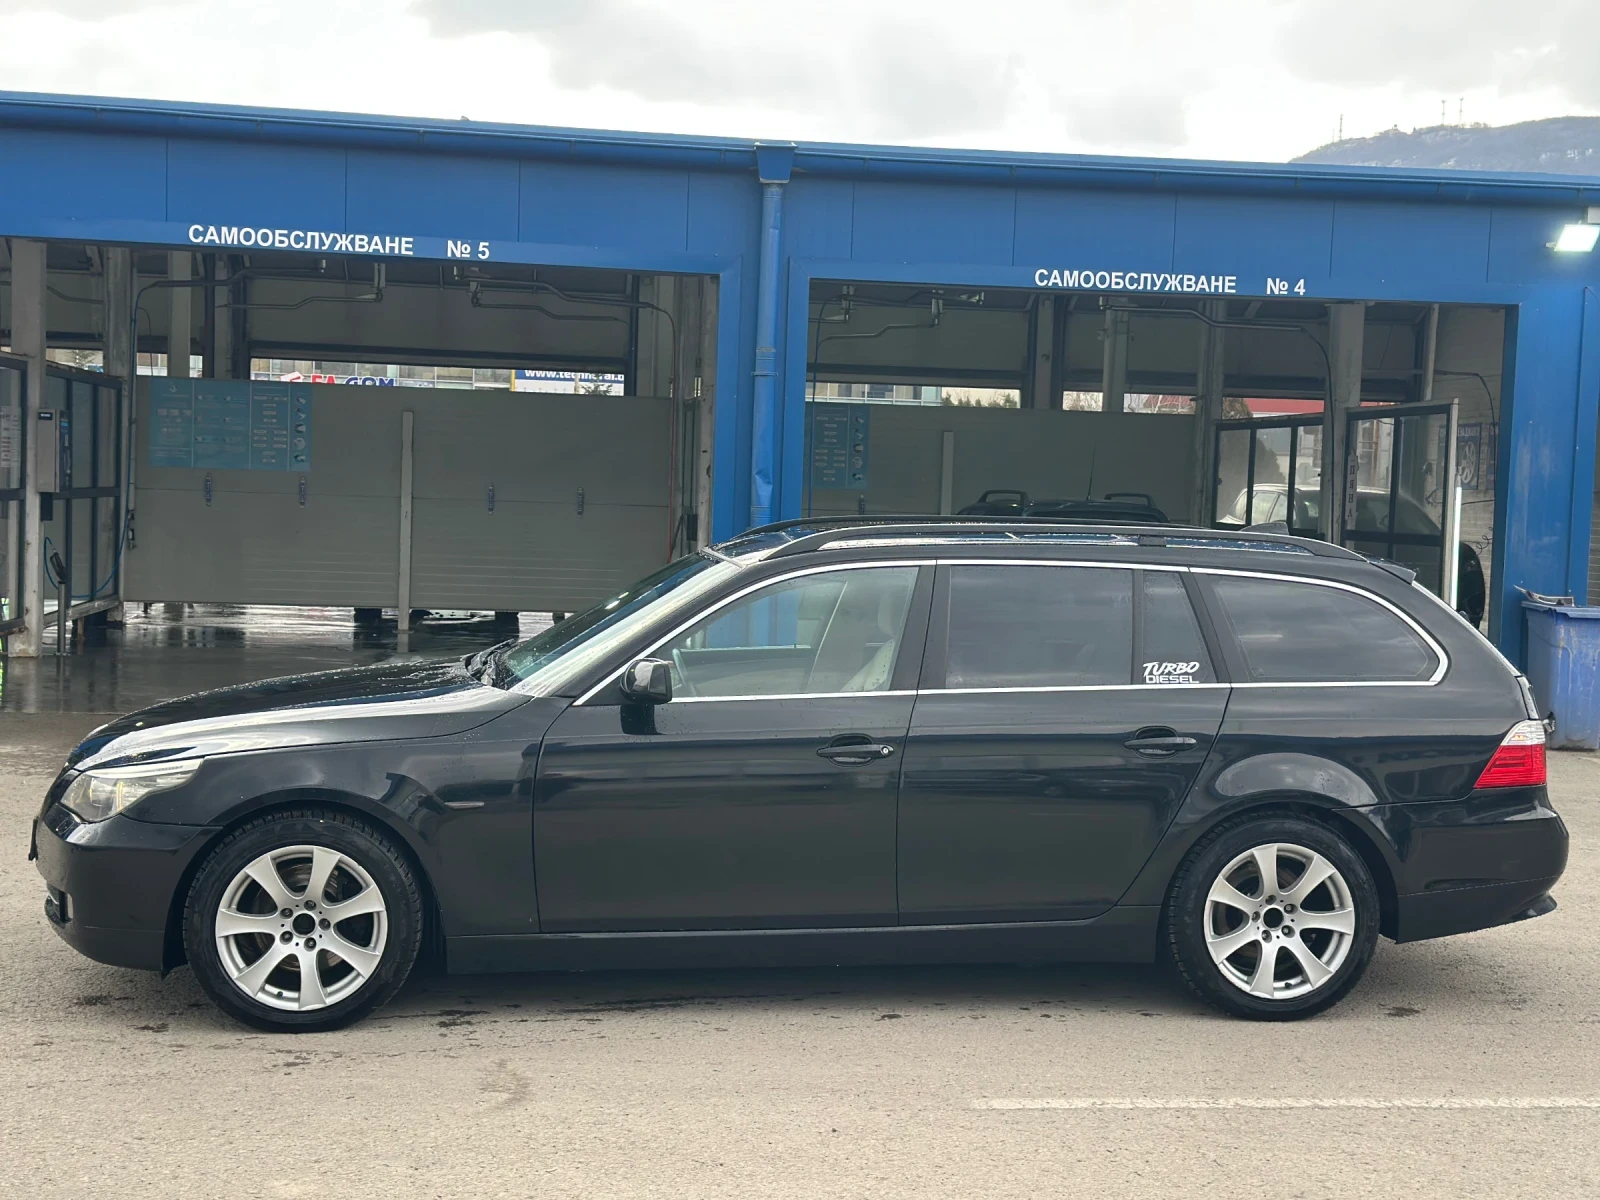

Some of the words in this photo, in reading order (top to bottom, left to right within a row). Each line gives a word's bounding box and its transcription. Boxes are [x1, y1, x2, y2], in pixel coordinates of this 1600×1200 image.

[188, 224, 414, 256] САМООБСЛУЖВАНЕ
[447, 240, 471, 258] №
[478, 242, 490, 260] 5
[1034, 268, 1236, 293] САМООБСЛУЖВАНЕ
[1266, 277, 1288, 295] №
[1294, 278, 1306, 296] 4
[1143, 661, 1200, 677] TURBO
[1146, 675, 1200, 684] DIESEL
